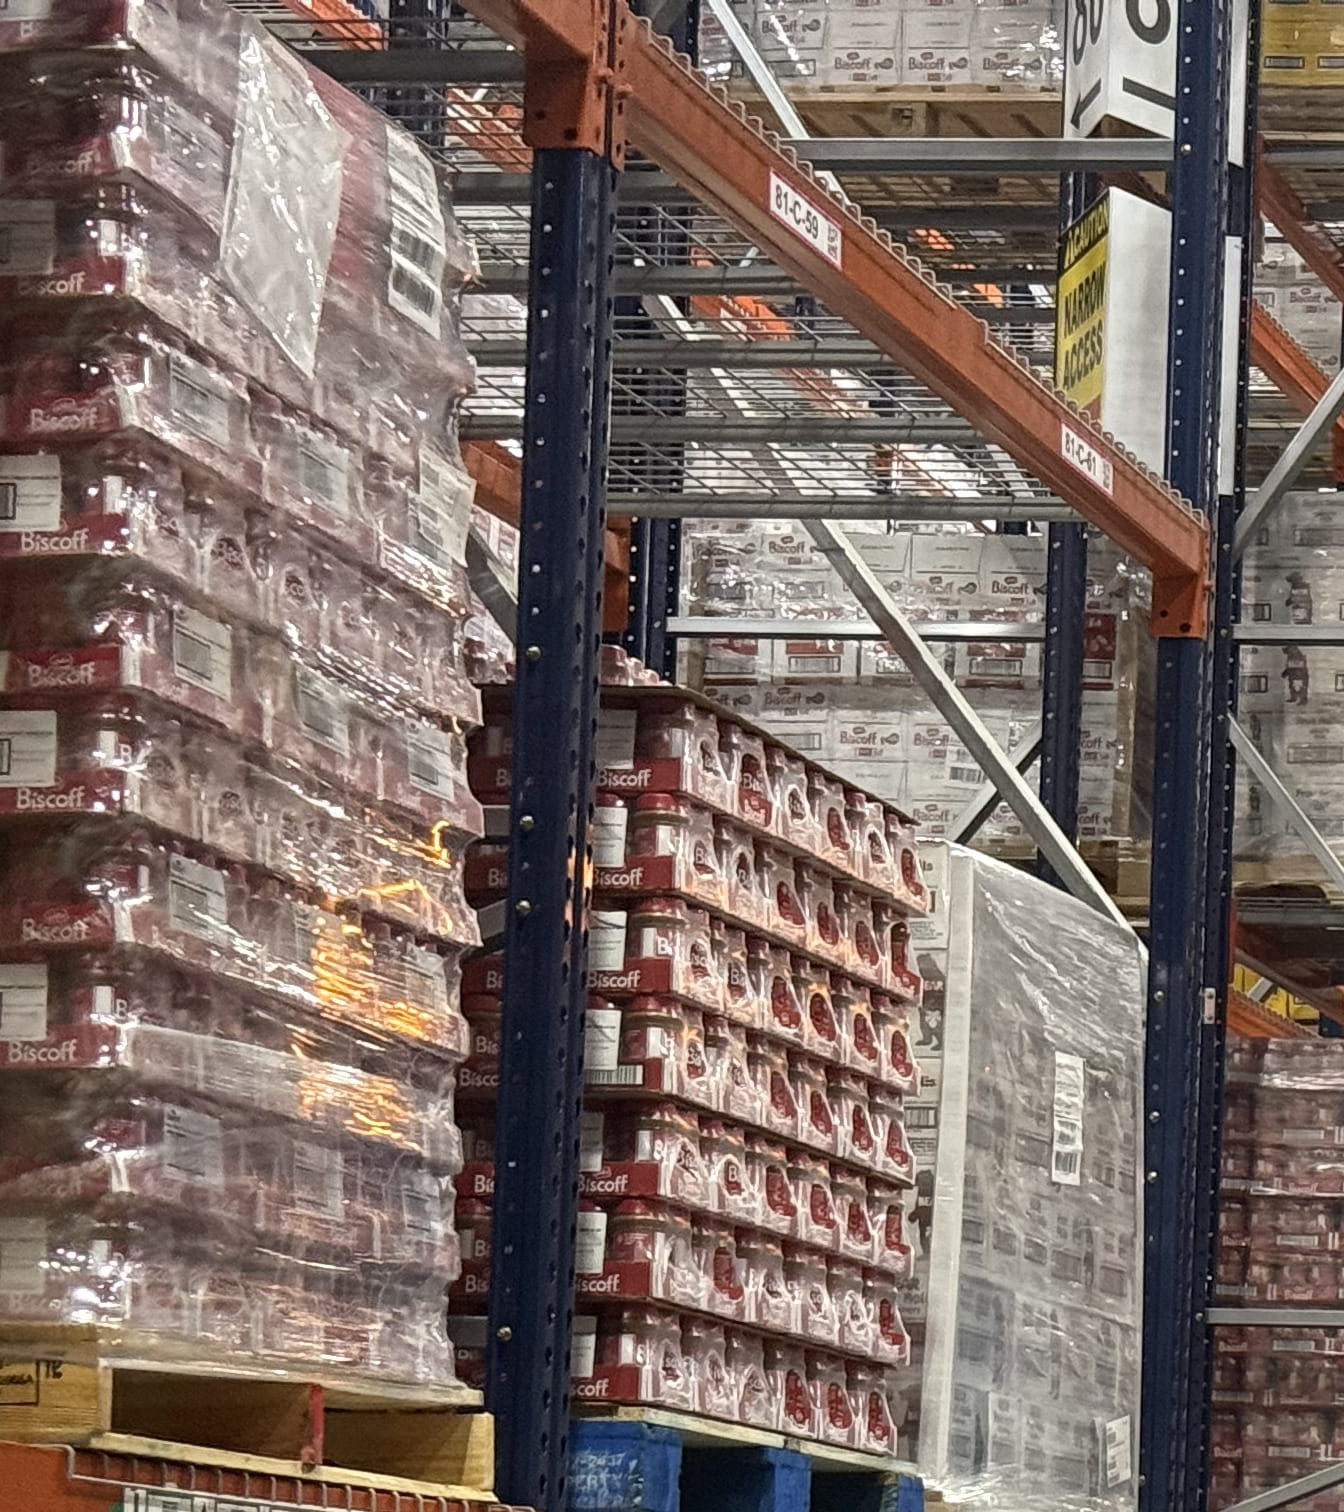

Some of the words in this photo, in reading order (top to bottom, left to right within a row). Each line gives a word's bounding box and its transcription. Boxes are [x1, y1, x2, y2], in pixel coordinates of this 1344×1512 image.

[775, 183, 821, 240] 81-C-59
[1064, 260, 1106, 338] NARROW
[1063, 319, 1104, 390] ACCESS
[30, 409, 98, 430] Biscoff
[21, 530, 89, 551] Biscoff
[28, 662, 96, 685] Biscoff
[839, 731, 877, 746] Biscoff
[914, 732, 948, 746] Biscof
[17, 787, 86, 809] Biscoff
[8, 1039, 77, 1062] Biscoff
[573, 1273, 620, 1293] iscoff
